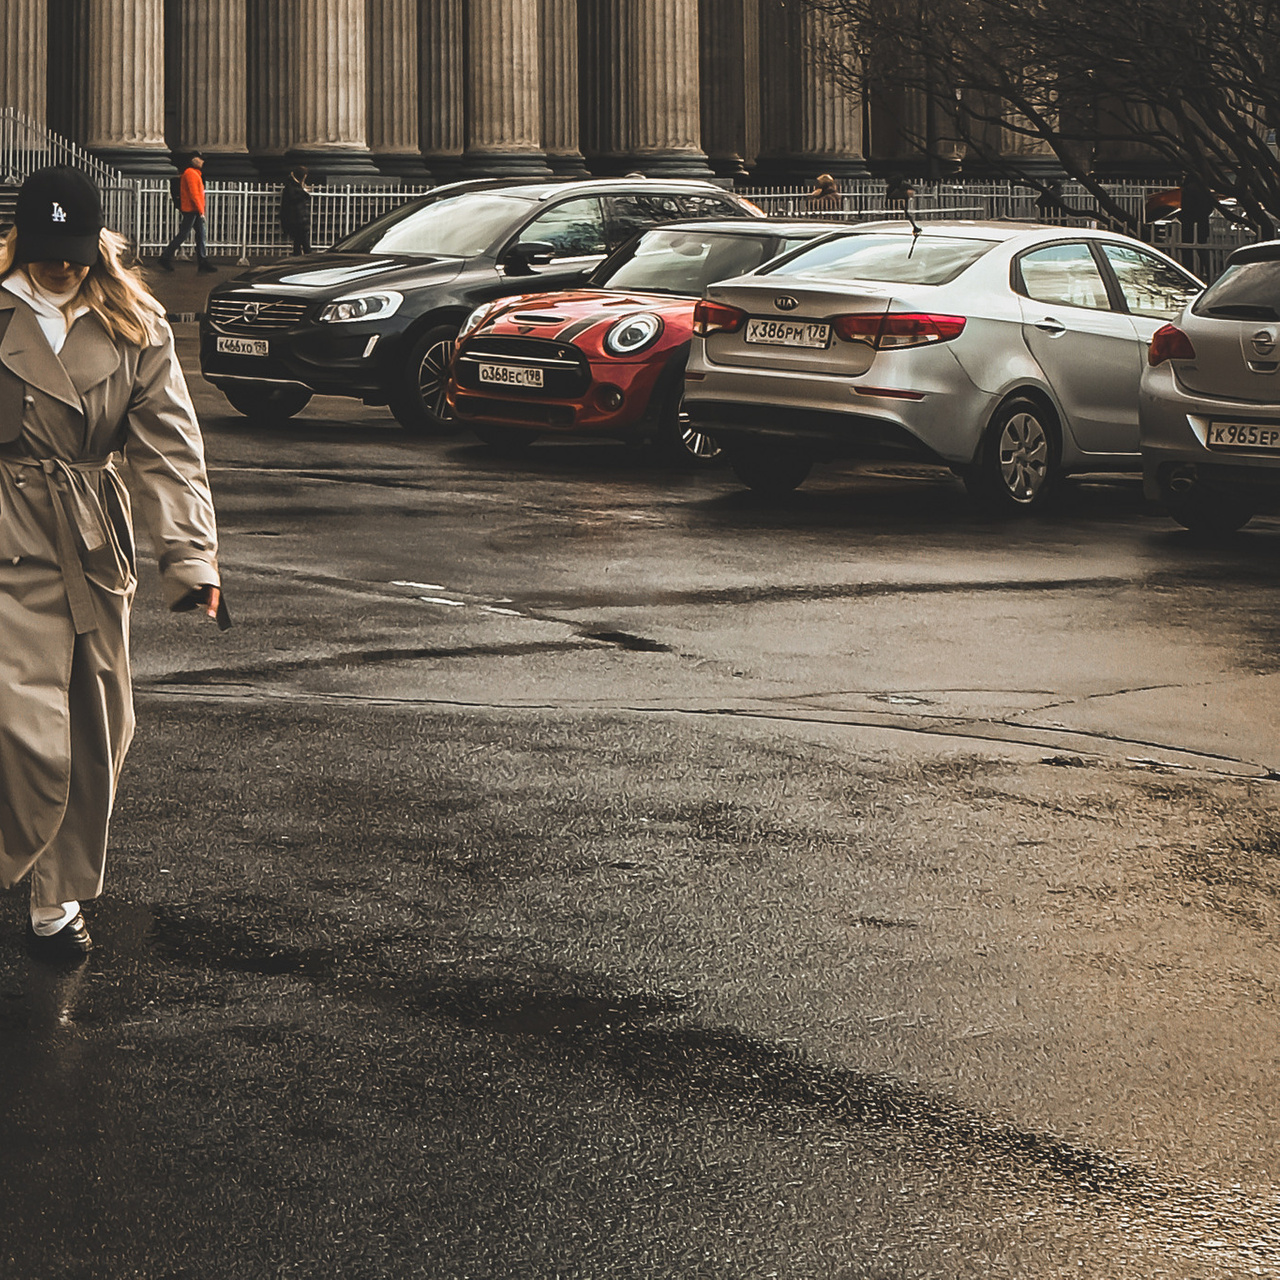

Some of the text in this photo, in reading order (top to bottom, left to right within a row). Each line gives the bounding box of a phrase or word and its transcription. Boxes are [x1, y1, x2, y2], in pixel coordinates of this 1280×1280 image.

[51, 202, 67, 222] LA
[776, 298, 793, 308] KIA
[807, 325, 826, 338] 178
